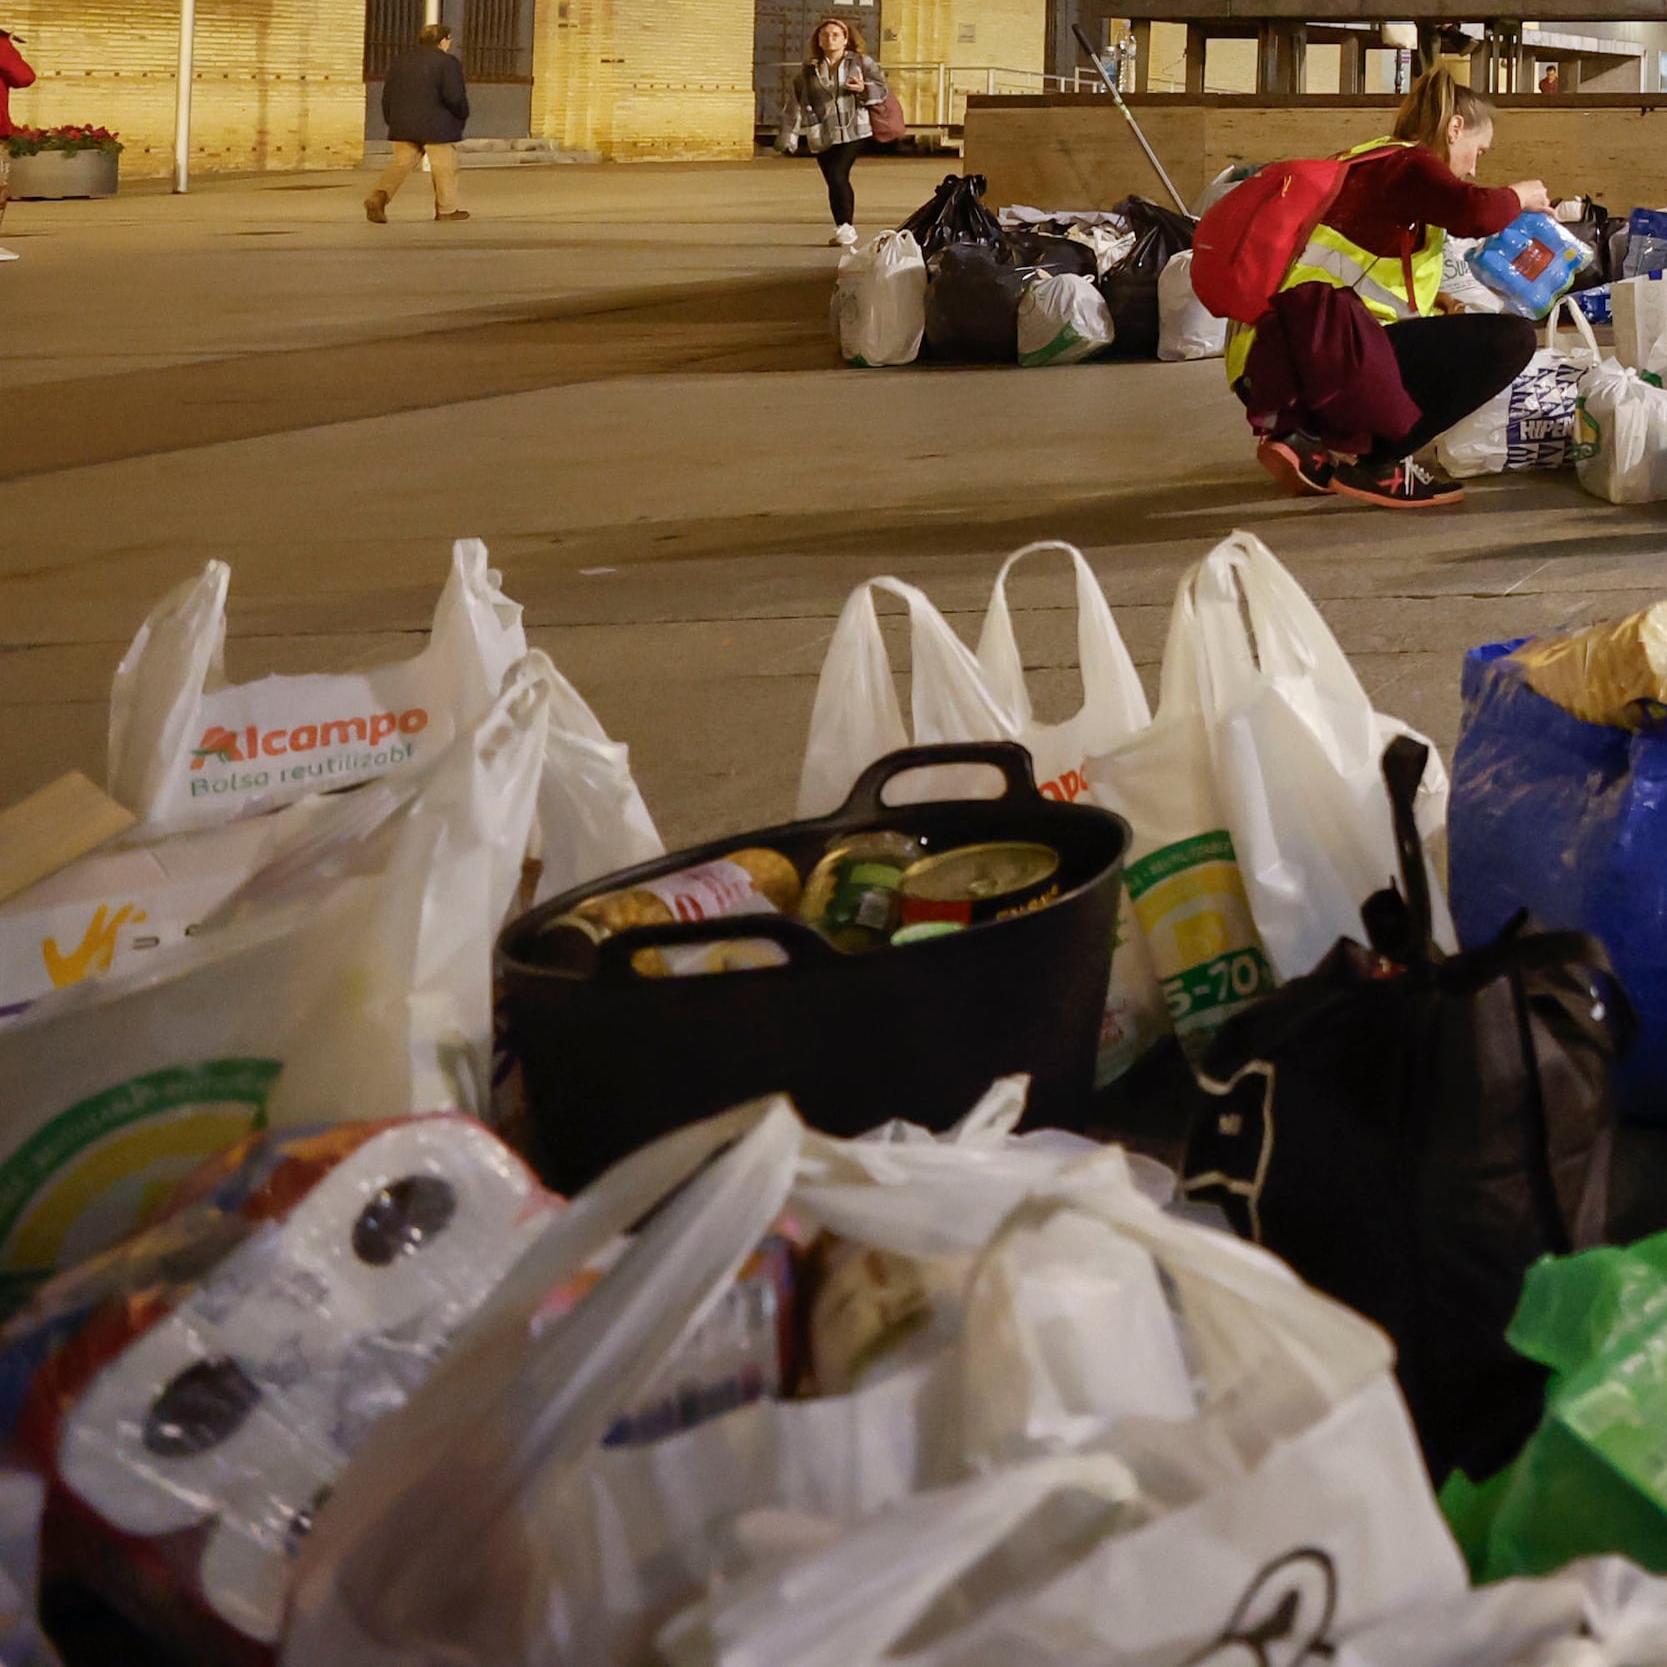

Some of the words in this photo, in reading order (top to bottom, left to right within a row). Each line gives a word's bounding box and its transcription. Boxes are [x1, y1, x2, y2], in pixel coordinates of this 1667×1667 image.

[189, 707, 429, 772] Alcampo
[190, 770, 269, 798] Bolsa
[280, 742, 415, 783] reutilizabl
